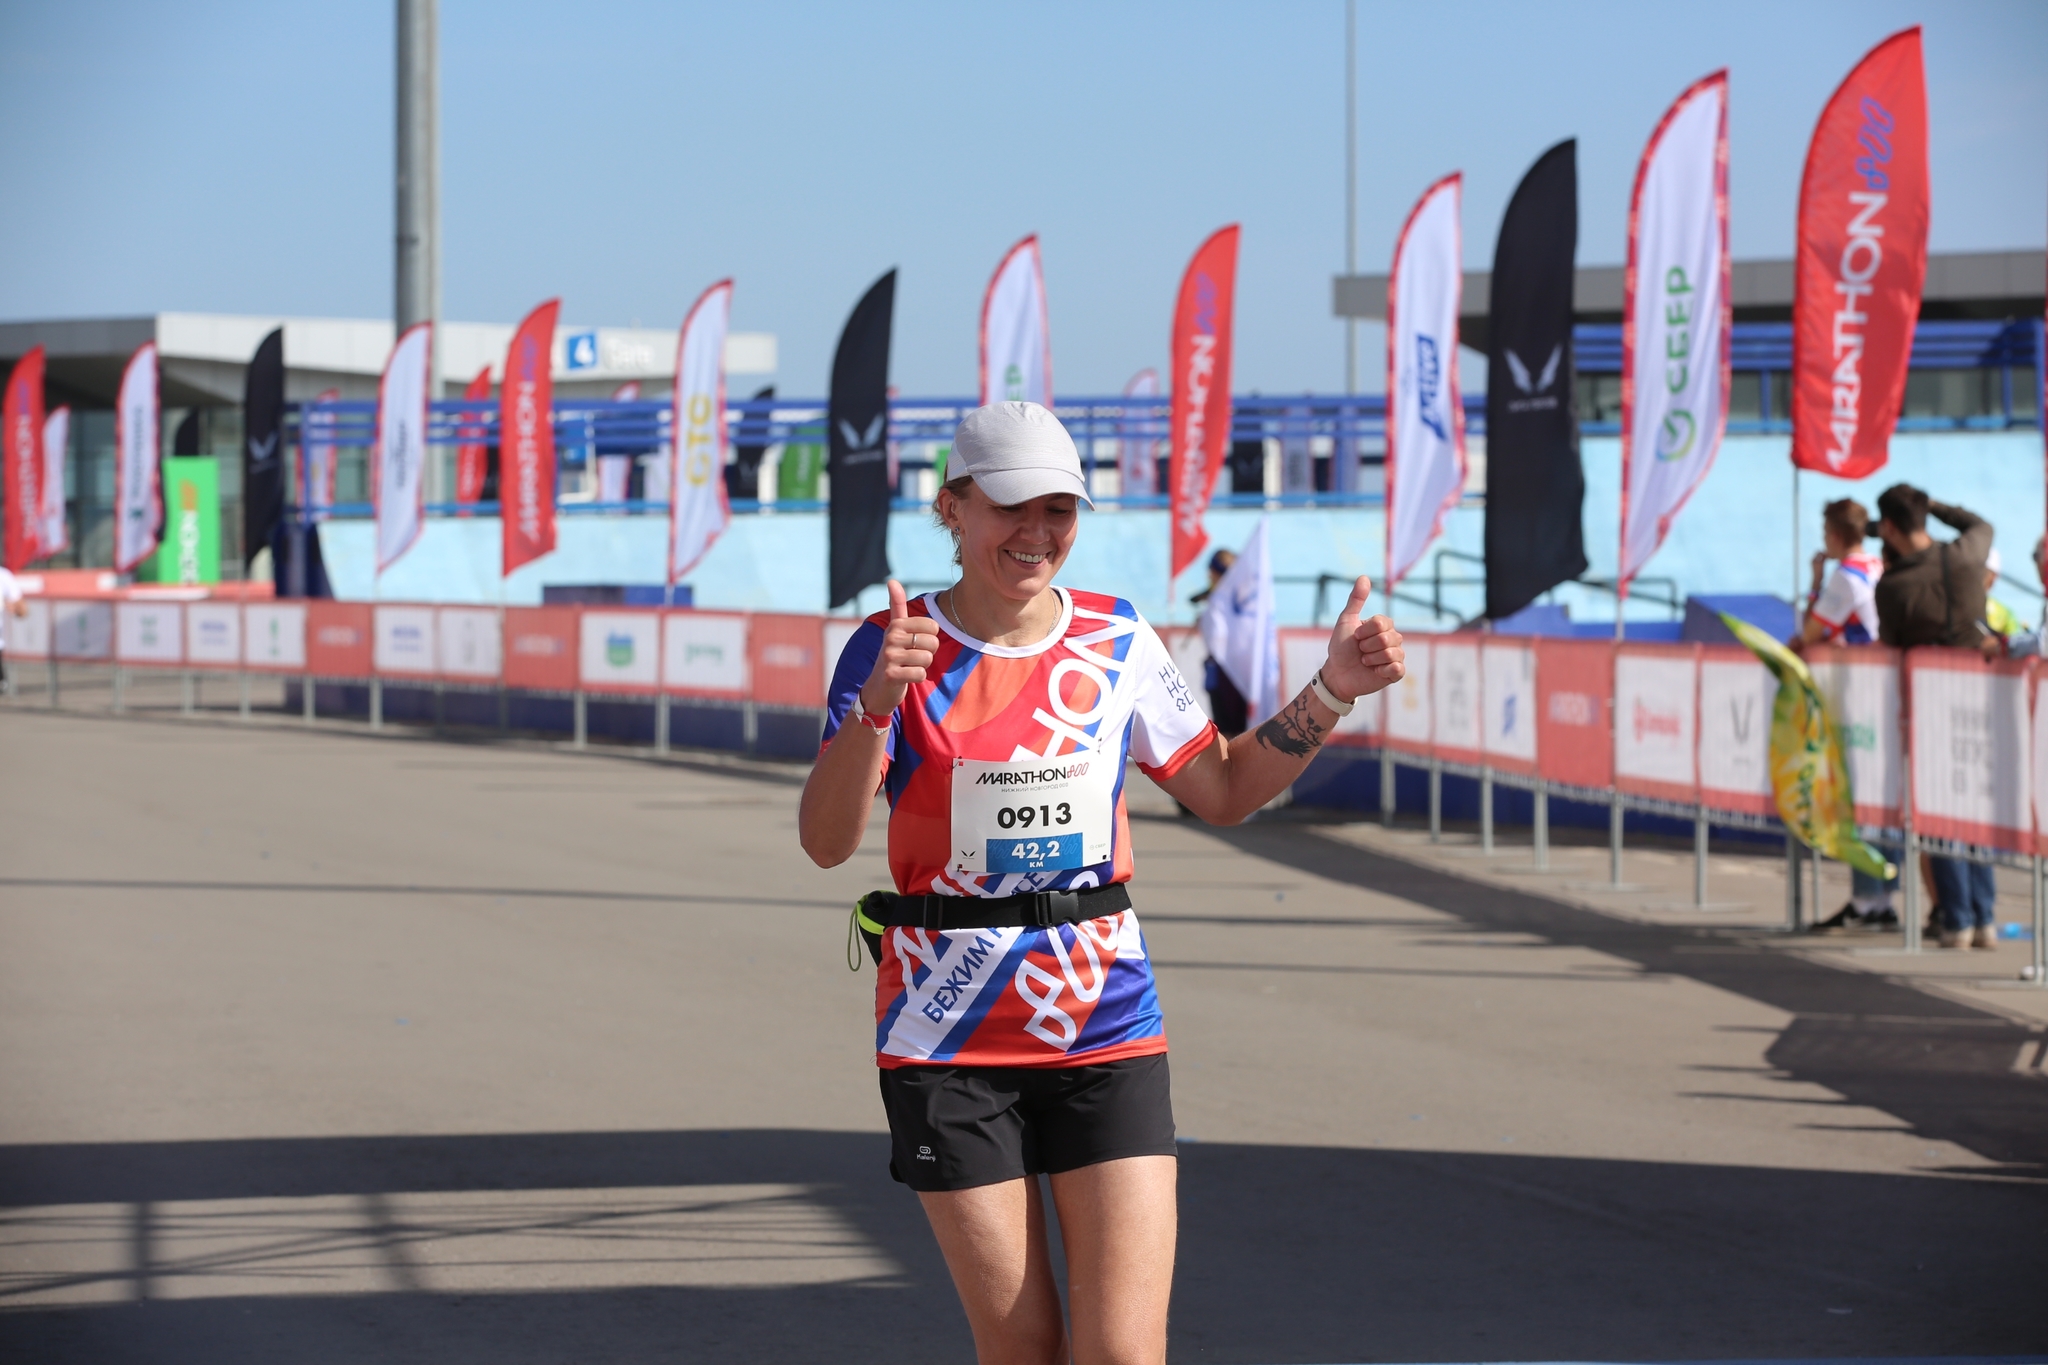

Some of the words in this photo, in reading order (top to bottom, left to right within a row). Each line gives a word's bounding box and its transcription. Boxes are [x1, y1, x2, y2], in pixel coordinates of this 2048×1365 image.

[997, 802, 1072, 829] 0913
[1011, 840, 1060, 861] 42,2
[922, 934, 995, 1024] БЕЖИМ
